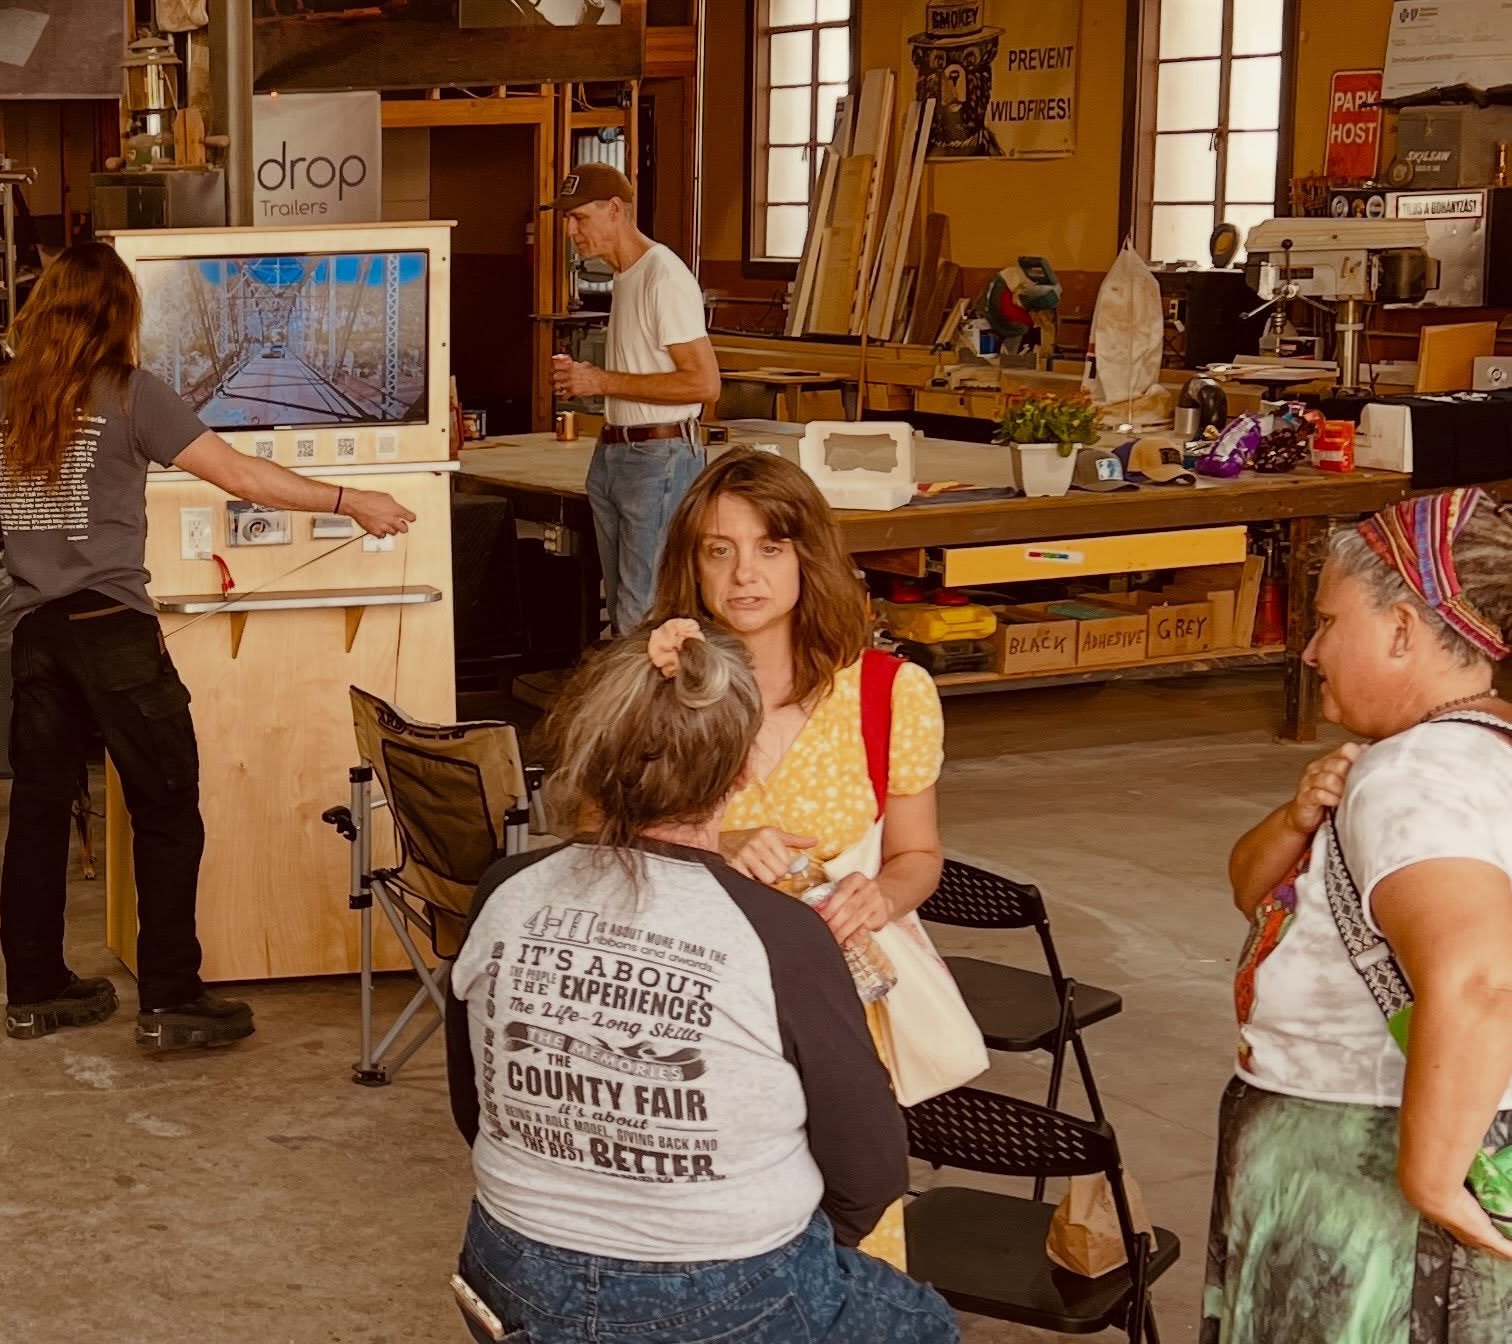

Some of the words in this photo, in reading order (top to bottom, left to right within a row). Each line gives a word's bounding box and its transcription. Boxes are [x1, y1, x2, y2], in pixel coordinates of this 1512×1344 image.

[931, 6, 979, 30] SMOKEY
[1008, 46, 1074, 71] PREVENT
[990, 97, 1071, 122] WILDFIRES!
[1333, 90, 1379, 112] PARK
[1330, 122, 1377, 144] HOST
[258, 141, 366, 201] drop
[260, 199, 328, 216] Trailers
[1081, 629, 1145, 652] ADHESIVE
[1157, 616, 1207, 640] GREY
[1008, 636, 1066, 655] BLACK
[523, 905, 599, 945] 4-H
[609, 922, 643, 941] ABOUT
[645, 930, 675, 949] MORE
[678, 938, 706, 958] THAN
[709, 948, 729, 966] THE
[593, 936, 638, 954] ribbons
[640, 944, 666, 960] and
[509, 965, 525, 979] THE
[526, 966, 557, 986] PEOPLE
[517, 943, 574, 972] IT'S
[584, 955, 713, 1001] ABOUT
[512, 977, 549, 997] THE
[559, 974, 714, 1028] EXPERIENCES
[509, 996, 535, 1016] The
[541, 1001, 643, 1040] Life-Long
[649, 1022, 704, 1043] Skills
[526, 1026, 566, 1049] THE
[570, 1039, 684, 1081] MEMORIES
[546, 1052, 572, 1069] THE
[507, 1060, 624, 1111] COUNTY
[633, 1084, 709, 1121] FAIR
[558, 1103, 585, 1117] it's
[592, 1112, 650, 1130] about
[509, 1119, 575, 1147] MAKING
[535, 1112, 543, 1124] A
[545, 1114, 570, 1131] ROLE
[617, 1129, 655, 1147] GIVING
[658, 1135, 690, 1150] BACK
[693, 1138, 718, 1152] AND
[521, 1133, 546, 1155] THE
[548, 1141, 584, 1162] BEST
[589, 1137, 717, 1178] BETTER
